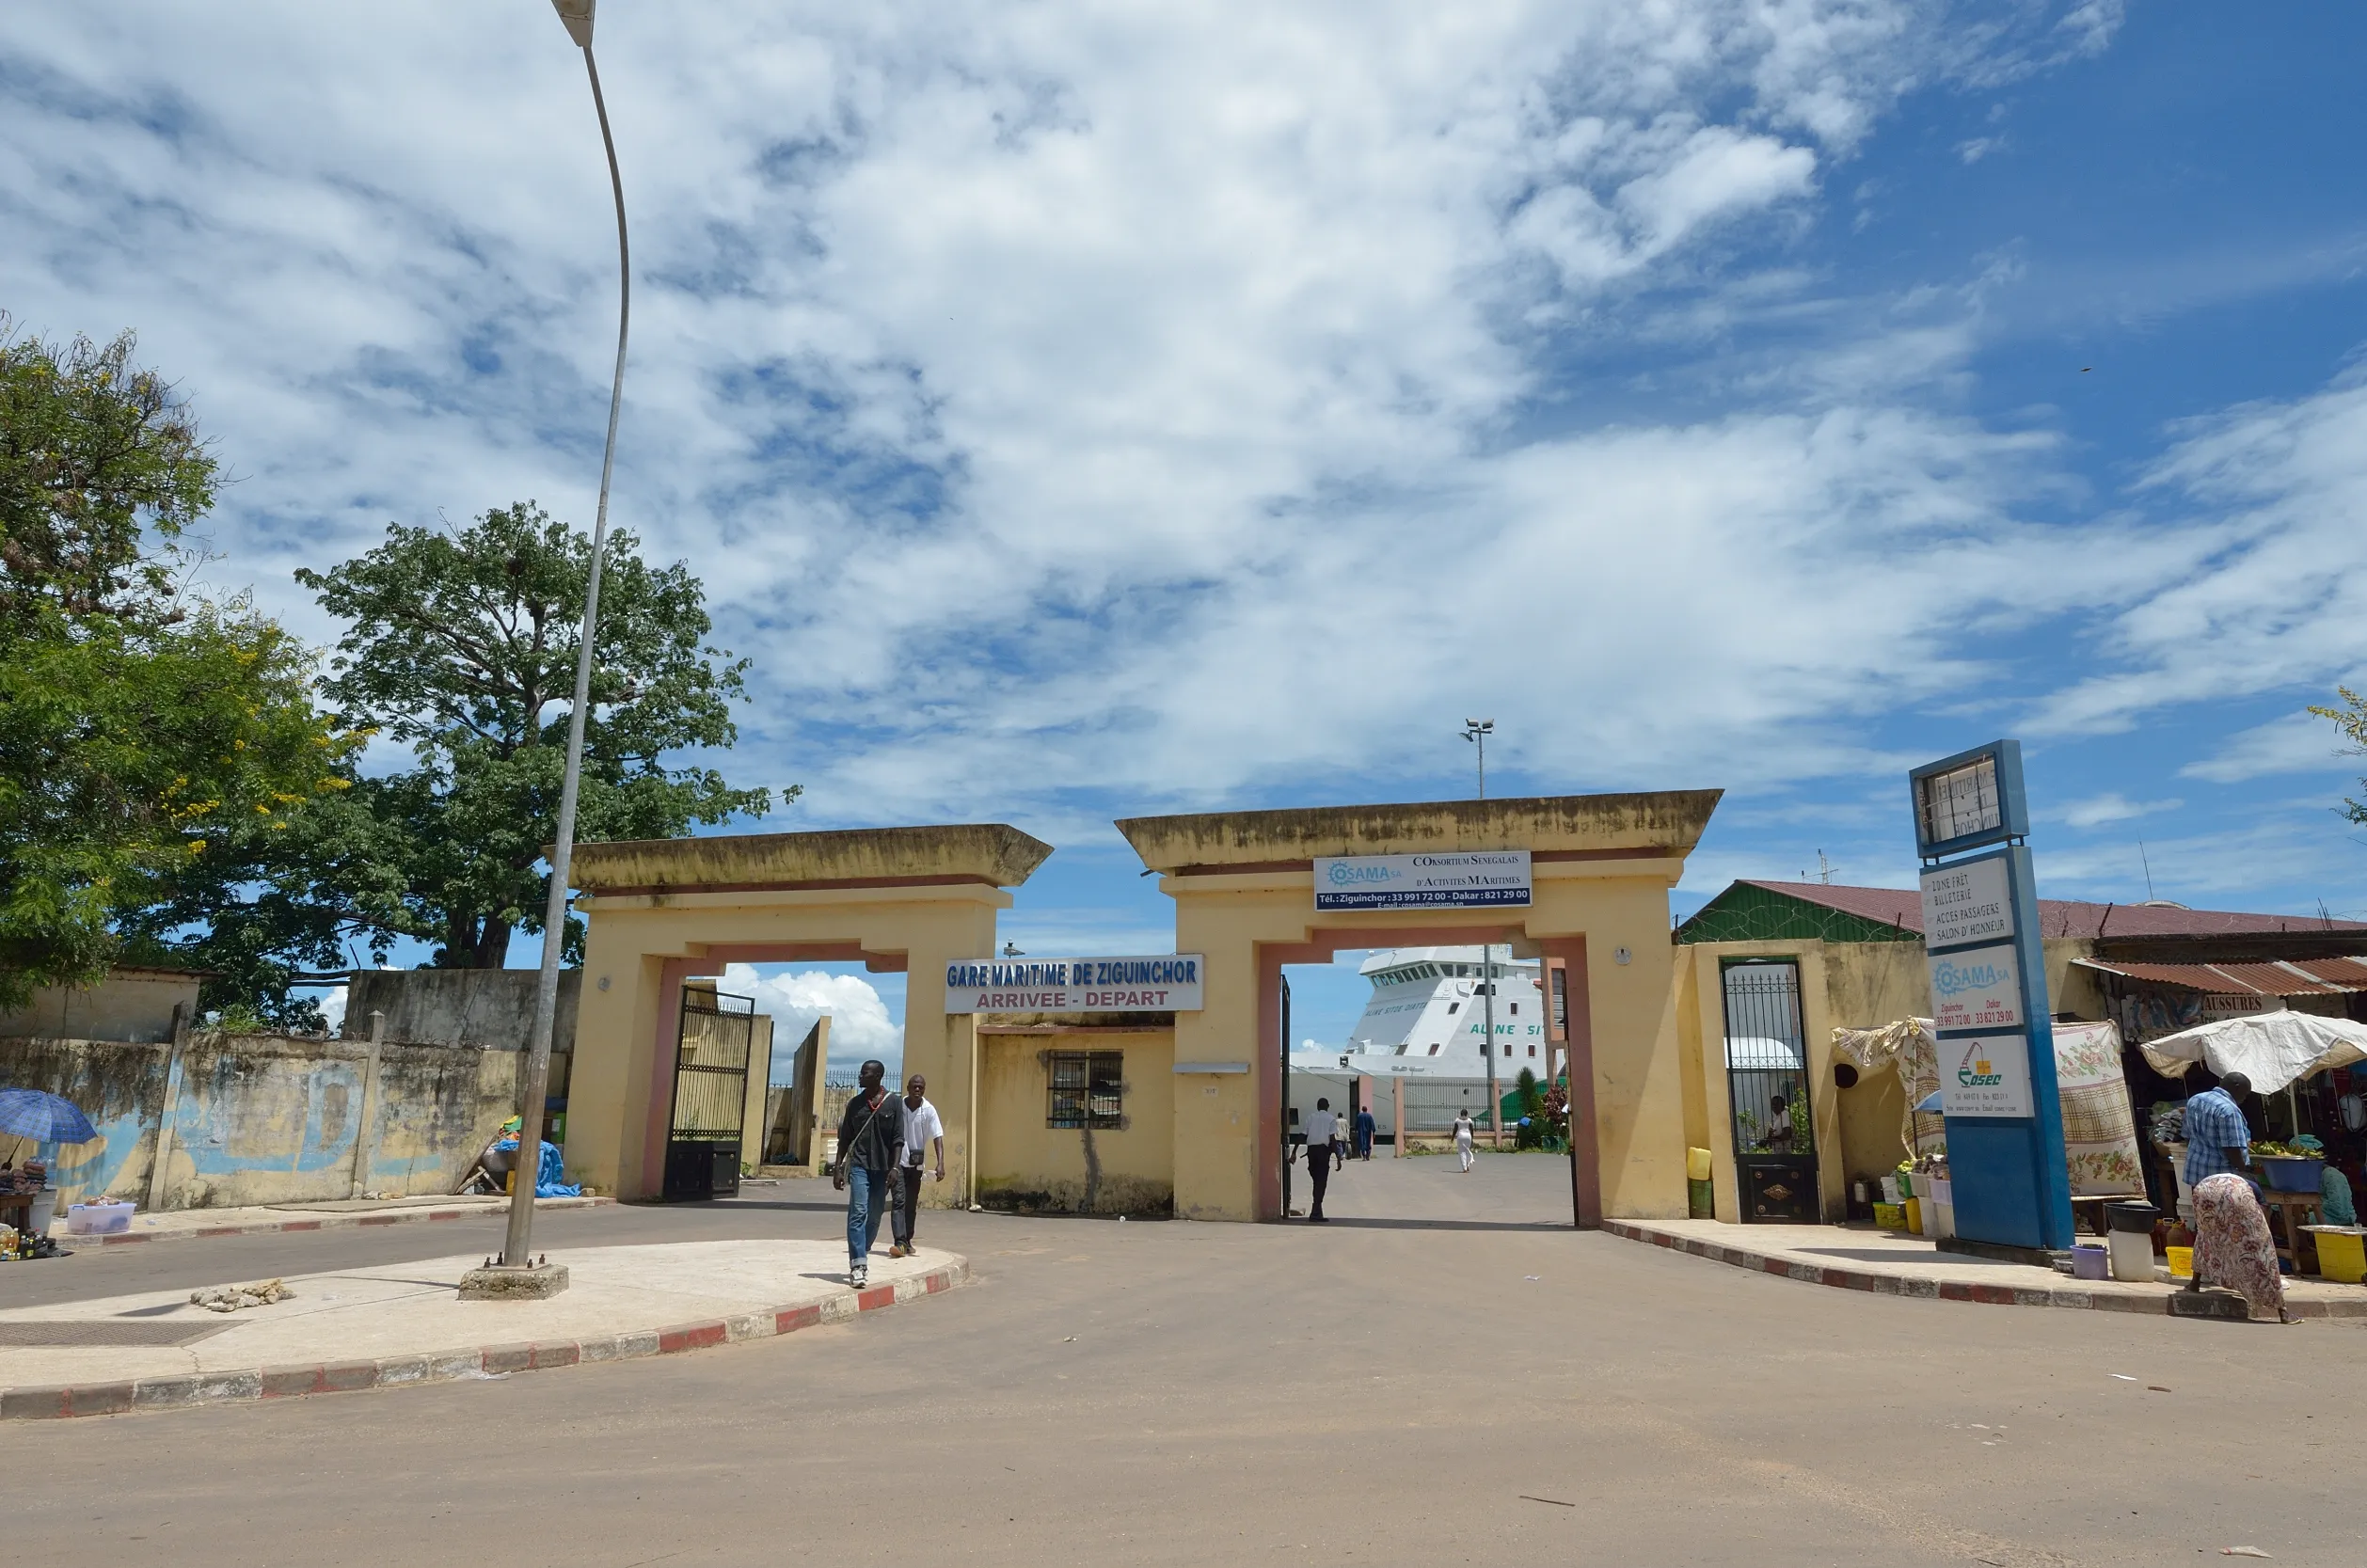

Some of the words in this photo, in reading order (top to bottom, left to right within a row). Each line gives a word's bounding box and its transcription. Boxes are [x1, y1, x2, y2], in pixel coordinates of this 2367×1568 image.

[1471, 855, 1519, 865] SENEGALAIS
[1468, 875, 1520, 886] MARITIMES
[1931, 878, 1950, 892] ZONE
[1952, 872, 1969, 888] FRÊT
[1392, 894, 1403, 902] 33
[1405, 893, 1420, 901] 991
[1422, 893, 1433, 901] 72
[1485, 891, 1501, 899] 821
[1503, 891, 1515, 899] 29
[1516, 890, 1528, 898] 00
[1934, 888, 1972, 906] BILLETERIE
[1960, 903, 1999, 920] PASSAGERS
[1937, 927, 1960, 941] SALON
[1970, 919, 2005, 935] HONNEUR
[946, 965, 988, 988] GARE
[991, 963, 1067, 987] MARITIME
[1072, 963, 1092, 986] DE
[1097, 960, 1197, 985] ZIGUINCHOR
[977, 992, 1066, 1008] ARRIVEE
[1086, 990, 1168, 1006] DEPART
[1986, 998, 2001, 1009] Dakar
[1945, 1015, 1954, 1025] 991
[1963, 1014, 1971, 1024] 00
[1976, 1012, 1983, 1023] 33
[1984, 1011, 1994, 1022] 821
[1996, 1011, 2005, 1022] 29
[2005, 1010, 2013, 1022] 00
[1470, 1023, 1516, 1035] ALNE
